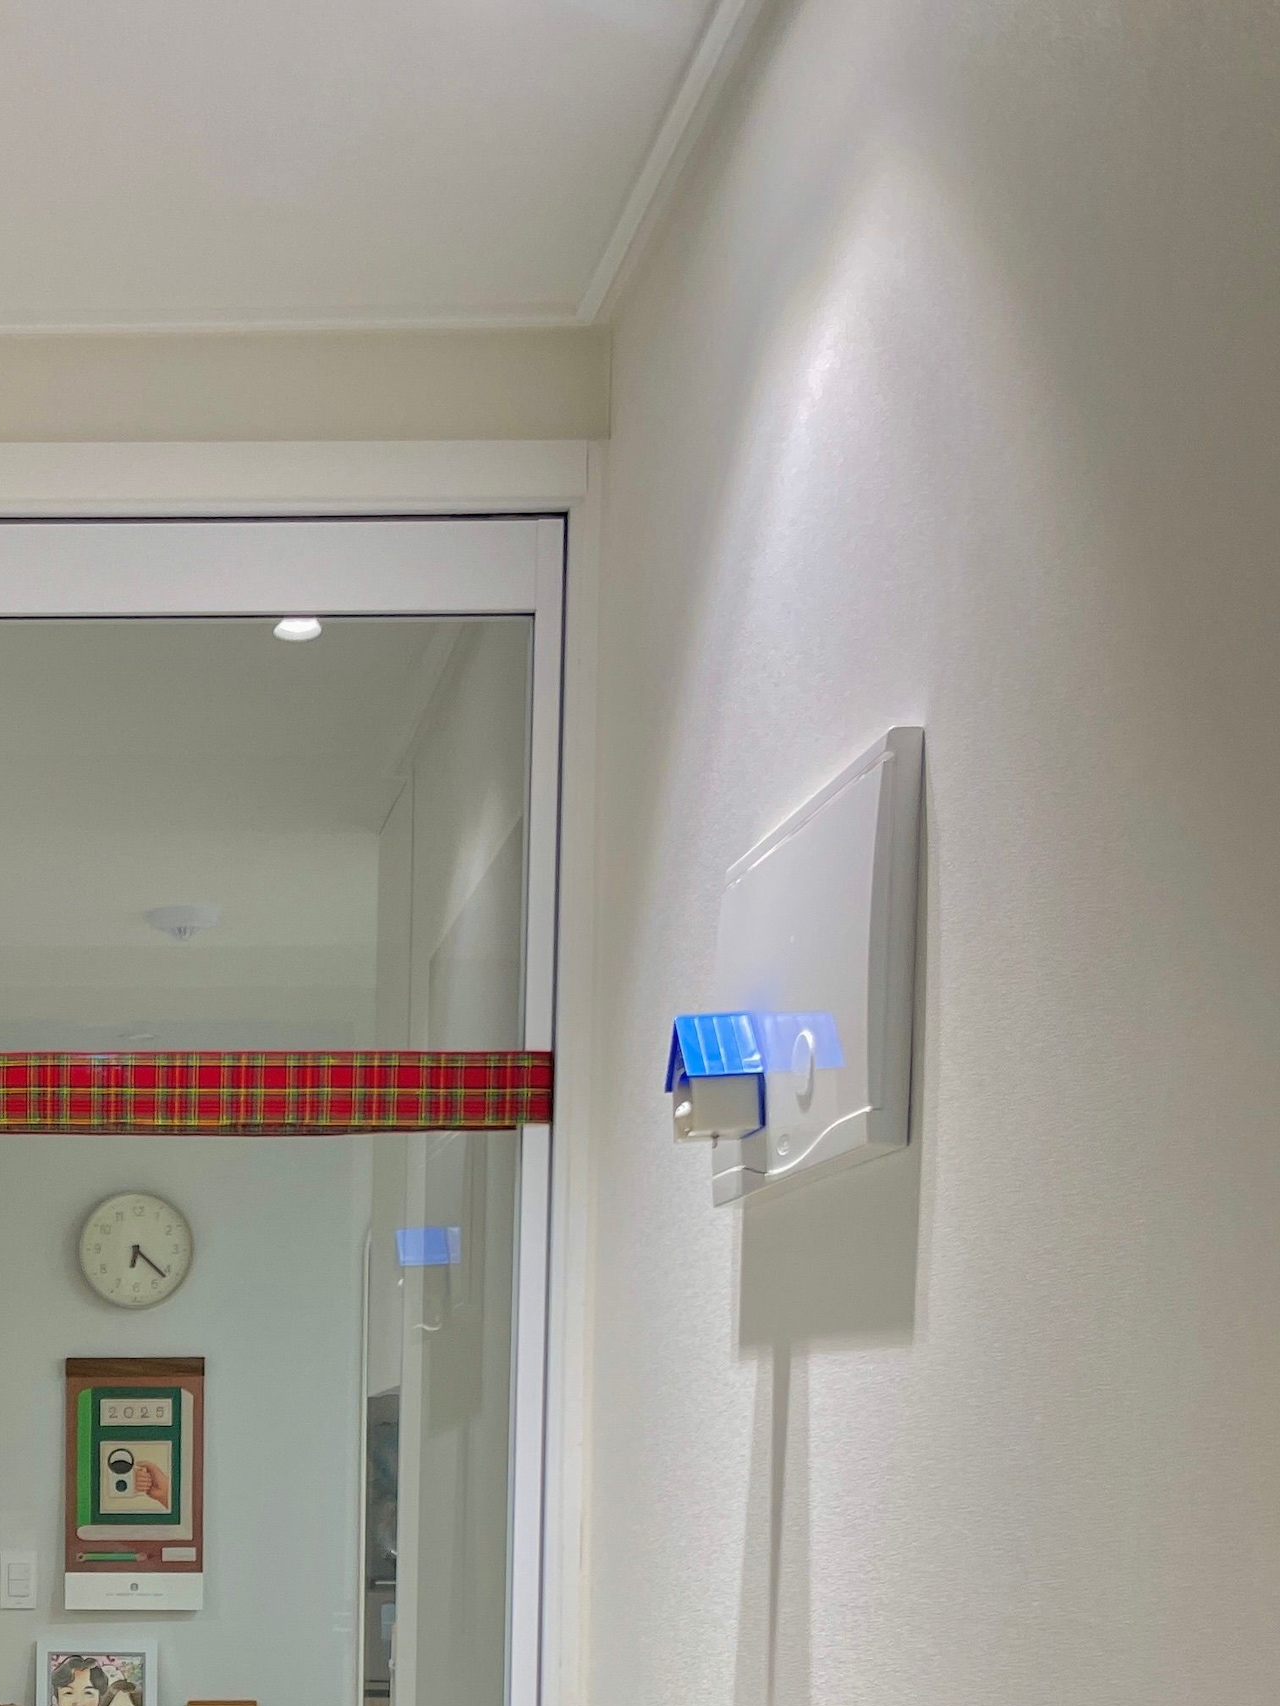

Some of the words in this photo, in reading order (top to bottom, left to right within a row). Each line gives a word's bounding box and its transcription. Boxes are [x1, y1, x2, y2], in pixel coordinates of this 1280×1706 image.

[115, 1211, 124, 1222] 11
[132, 1205, 146, 1217] 12
[165, 1224, 173, 1236] 2
[93, 1243, 102, 1254] 9
[172, 1244, 179, 1255] 3
[99, 1263, 108, 1274] 8
[164, 1264, 172, 1275] 4
[115, 1277, 122, 1288] 7
[132, 1282, 140, 1293] 6
[151, 1278, 158, 1289] 5
[108, 1406, 164, 1419] 2025
